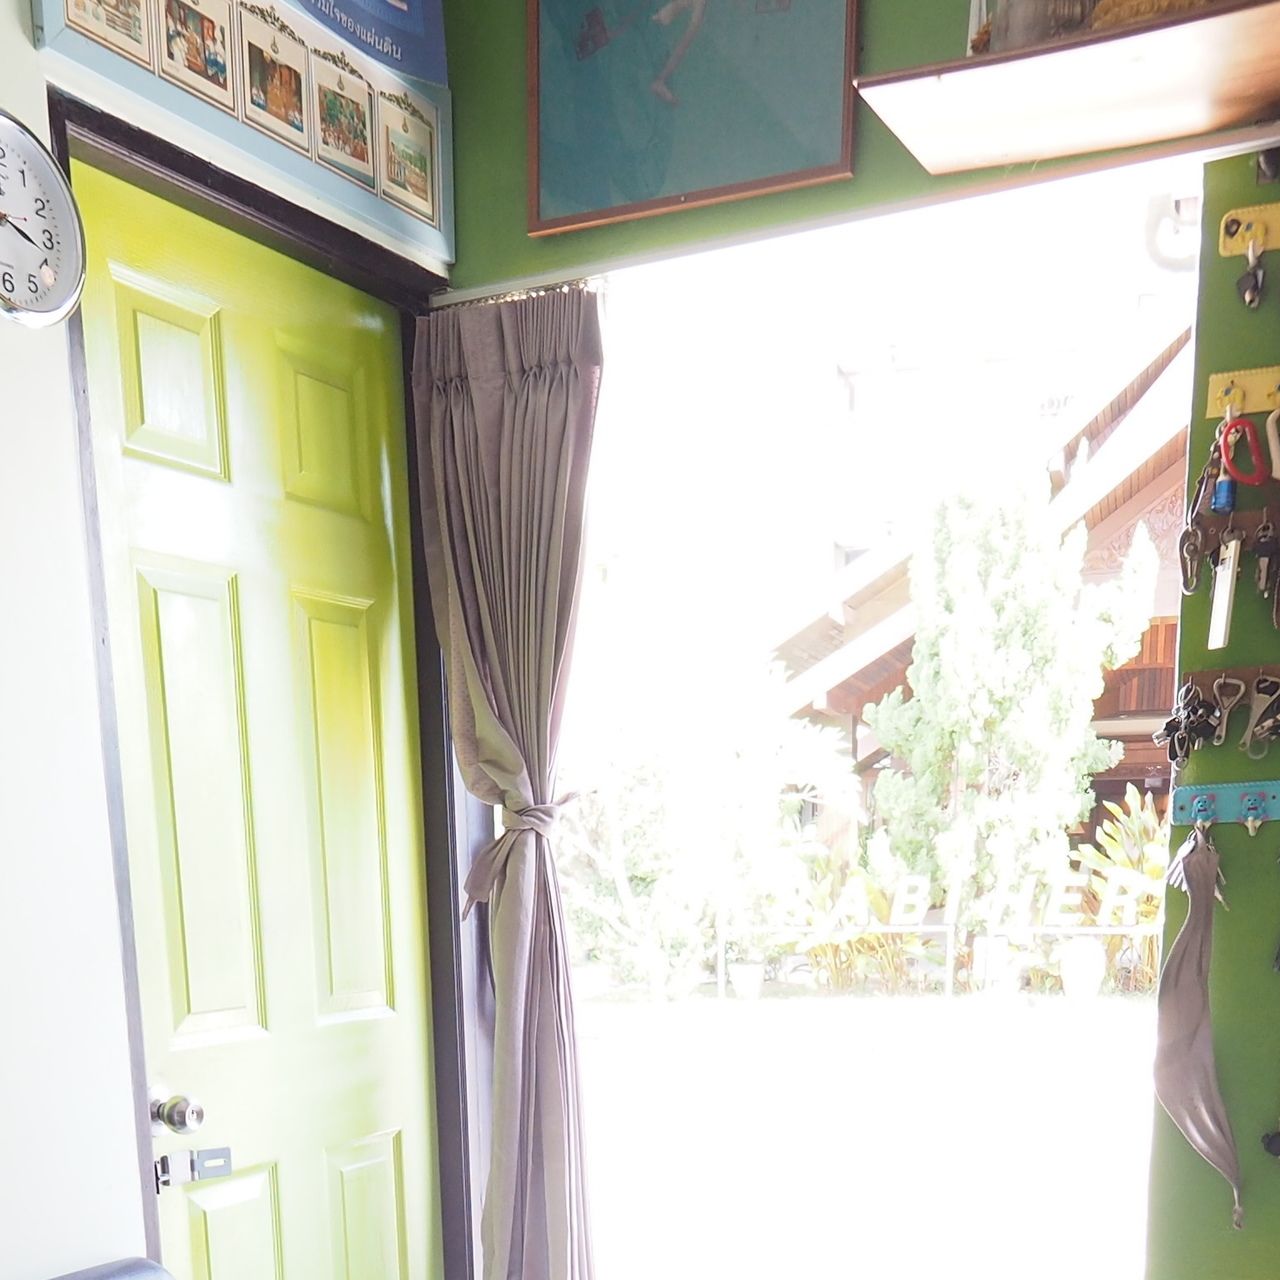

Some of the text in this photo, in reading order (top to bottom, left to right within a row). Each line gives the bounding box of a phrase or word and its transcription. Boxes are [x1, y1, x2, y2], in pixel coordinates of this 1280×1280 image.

[18, 168, 26, 188] 1
[34, 198, 48, 219] 2
[42, 229, 54, 250] 3
[2, 271, 15, 293] 6
[28, 273, 39, 294] 5
